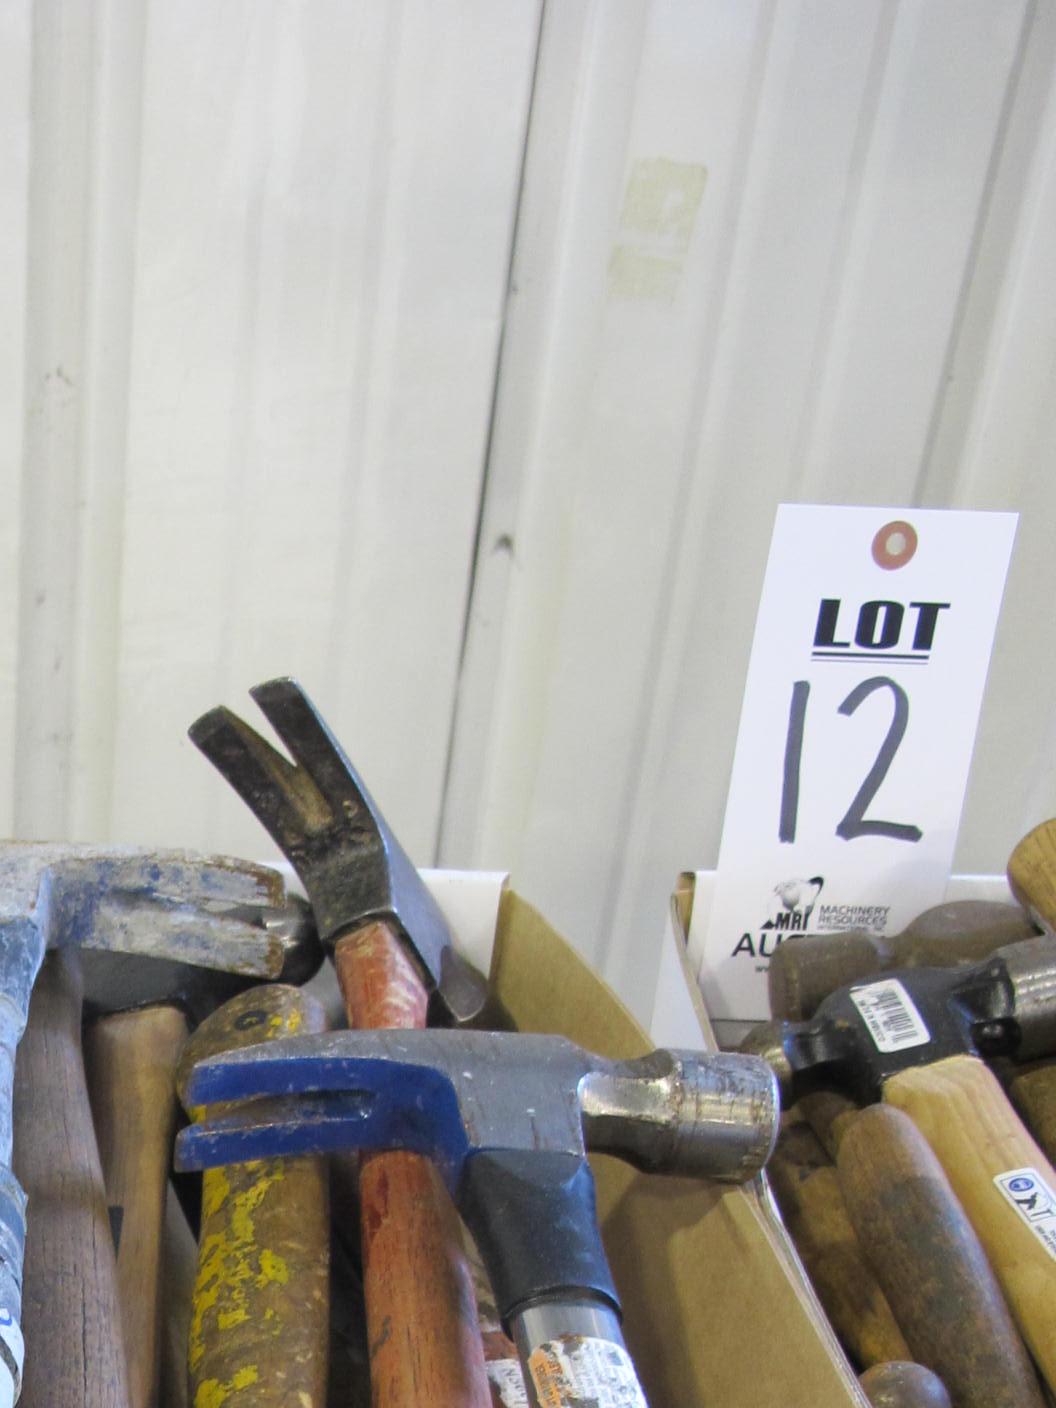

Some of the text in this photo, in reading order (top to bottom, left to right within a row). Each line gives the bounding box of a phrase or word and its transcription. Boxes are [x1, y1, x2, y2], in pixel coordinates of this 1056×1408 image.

[812, 598, 951, 651] LOT
[778, 675, 924, 843] 12
[775, 905, 813, 931] MRI
[817, 914, 888, 926] RESOURCES
[819, 904, 891, 916] MACHINERY
